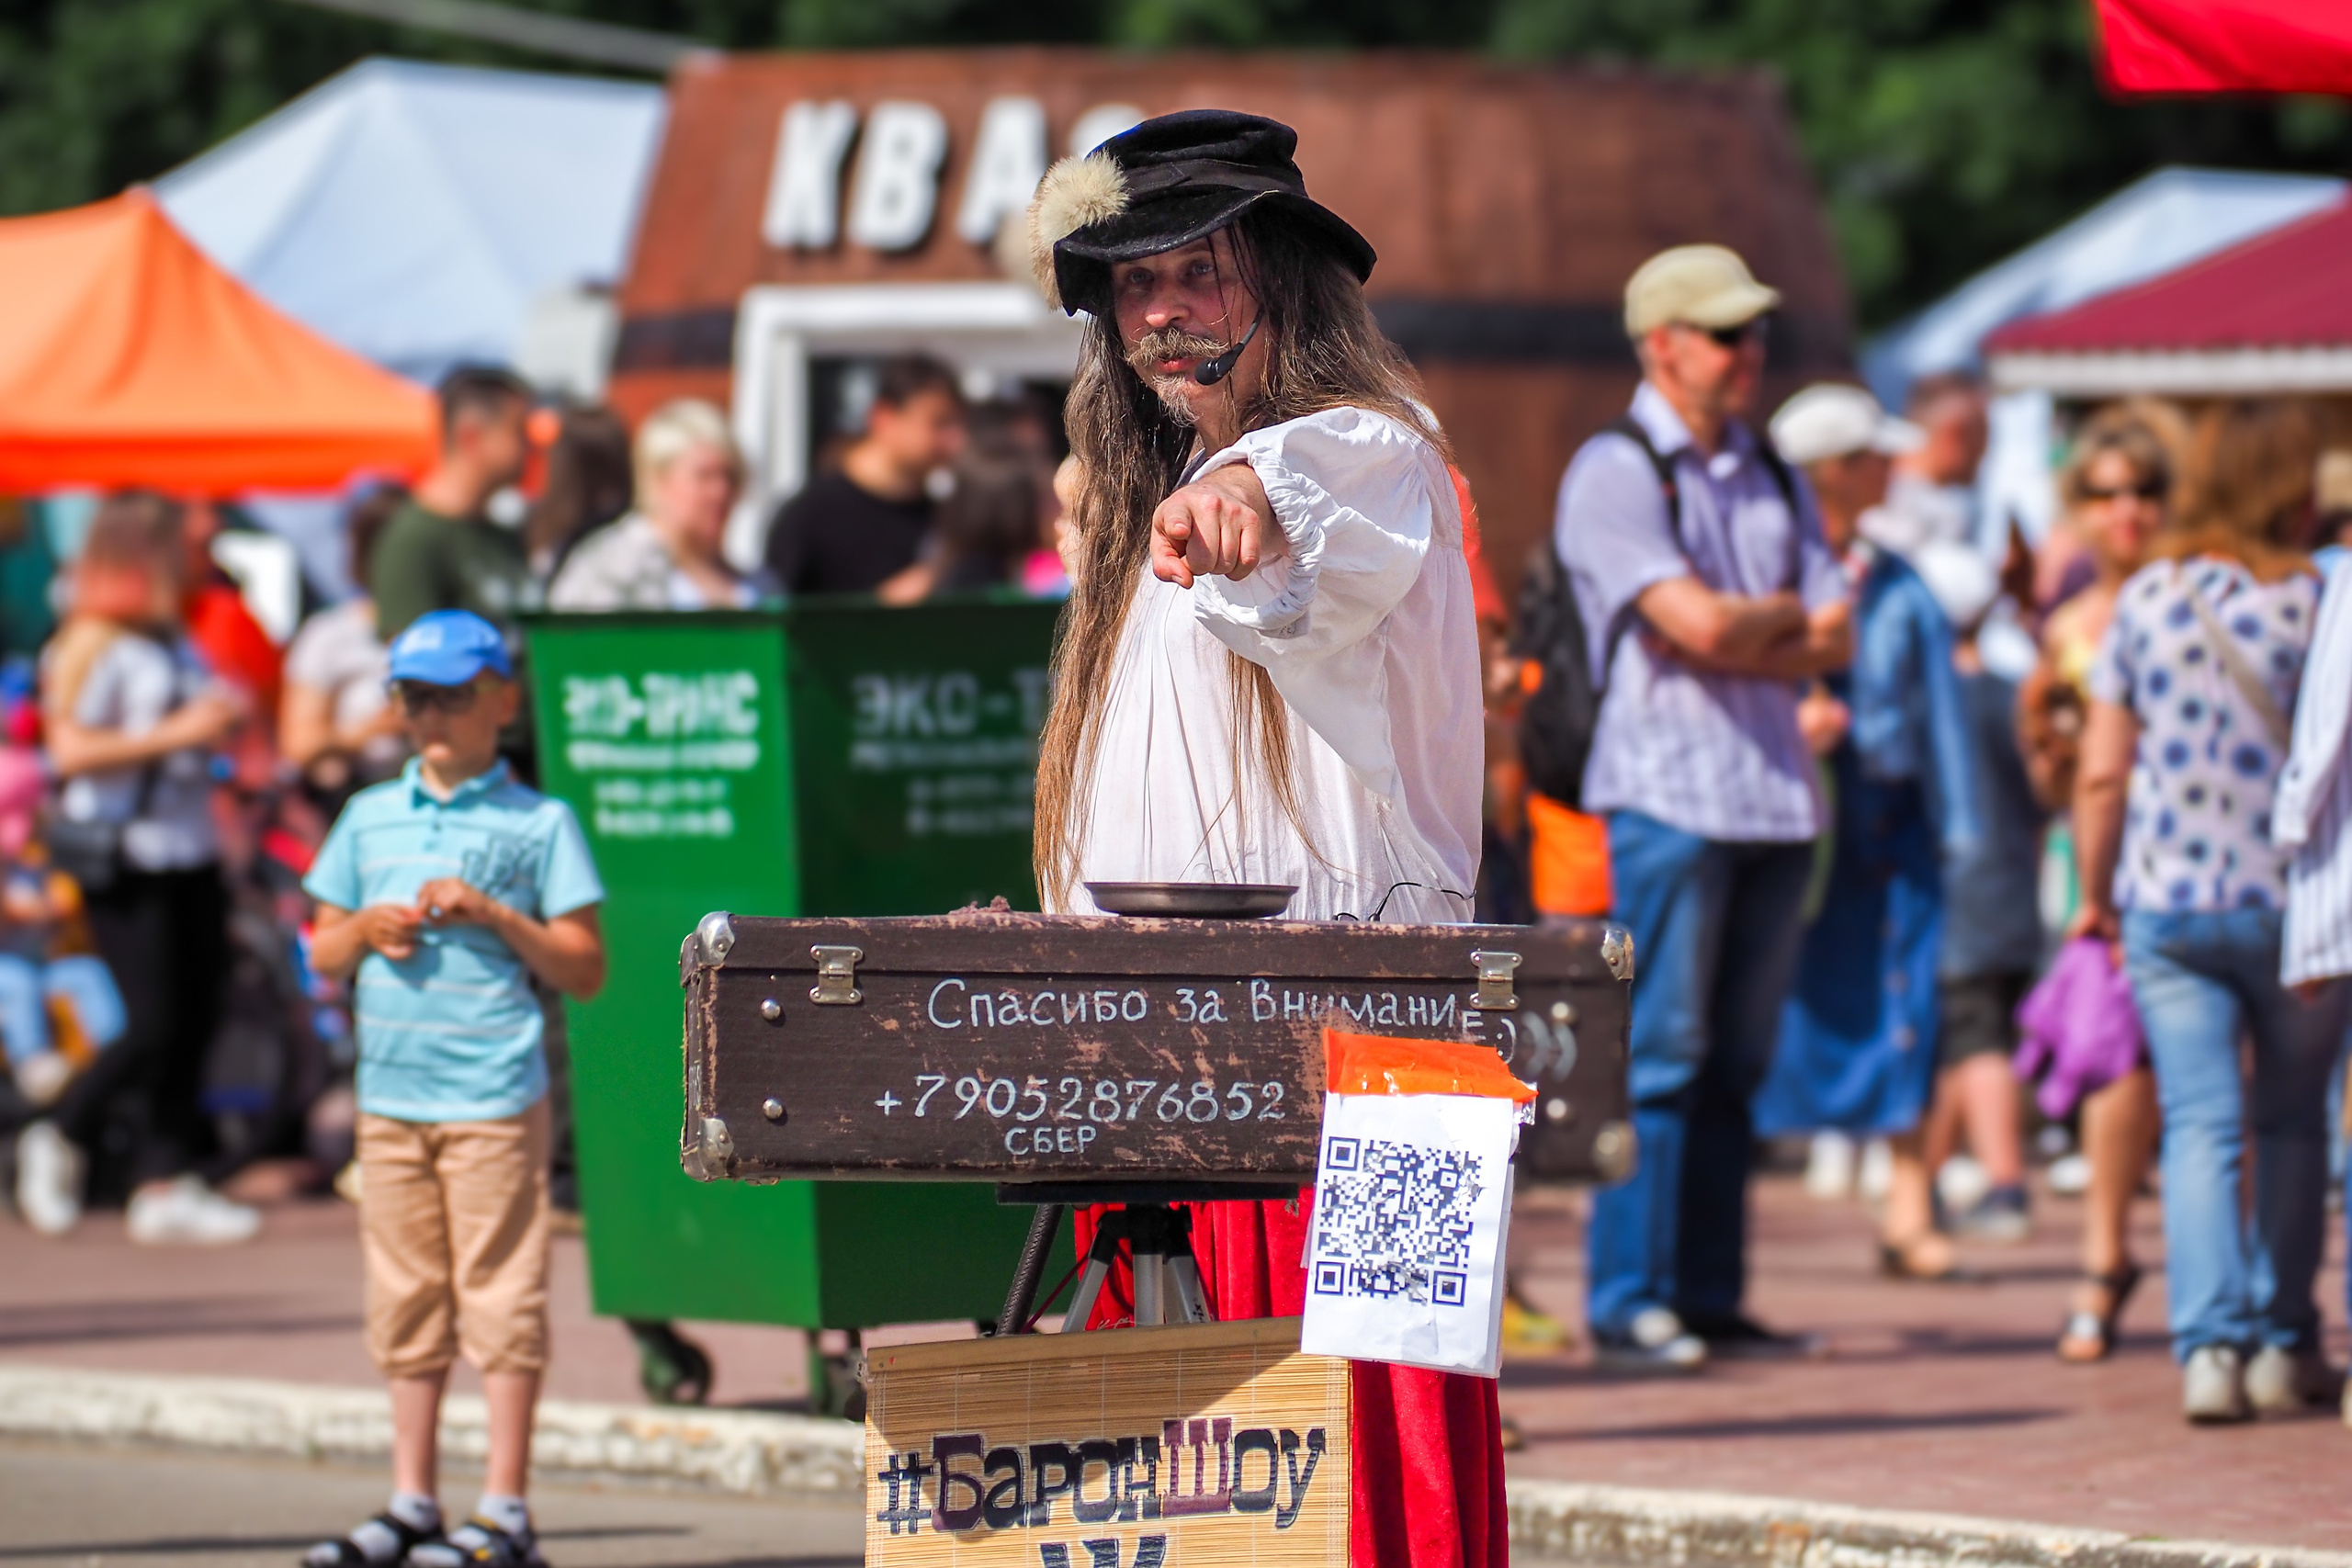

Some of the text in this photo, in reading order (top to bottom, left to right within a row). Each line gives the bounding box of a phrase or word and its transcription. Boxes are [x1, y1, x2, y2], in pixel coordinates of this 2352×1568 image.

[1175, 987, 1228, 1024] за
[873, 1075, 1287, 1123] +79052876852
[1003, 1125, 1098, 1156] СБЕР
